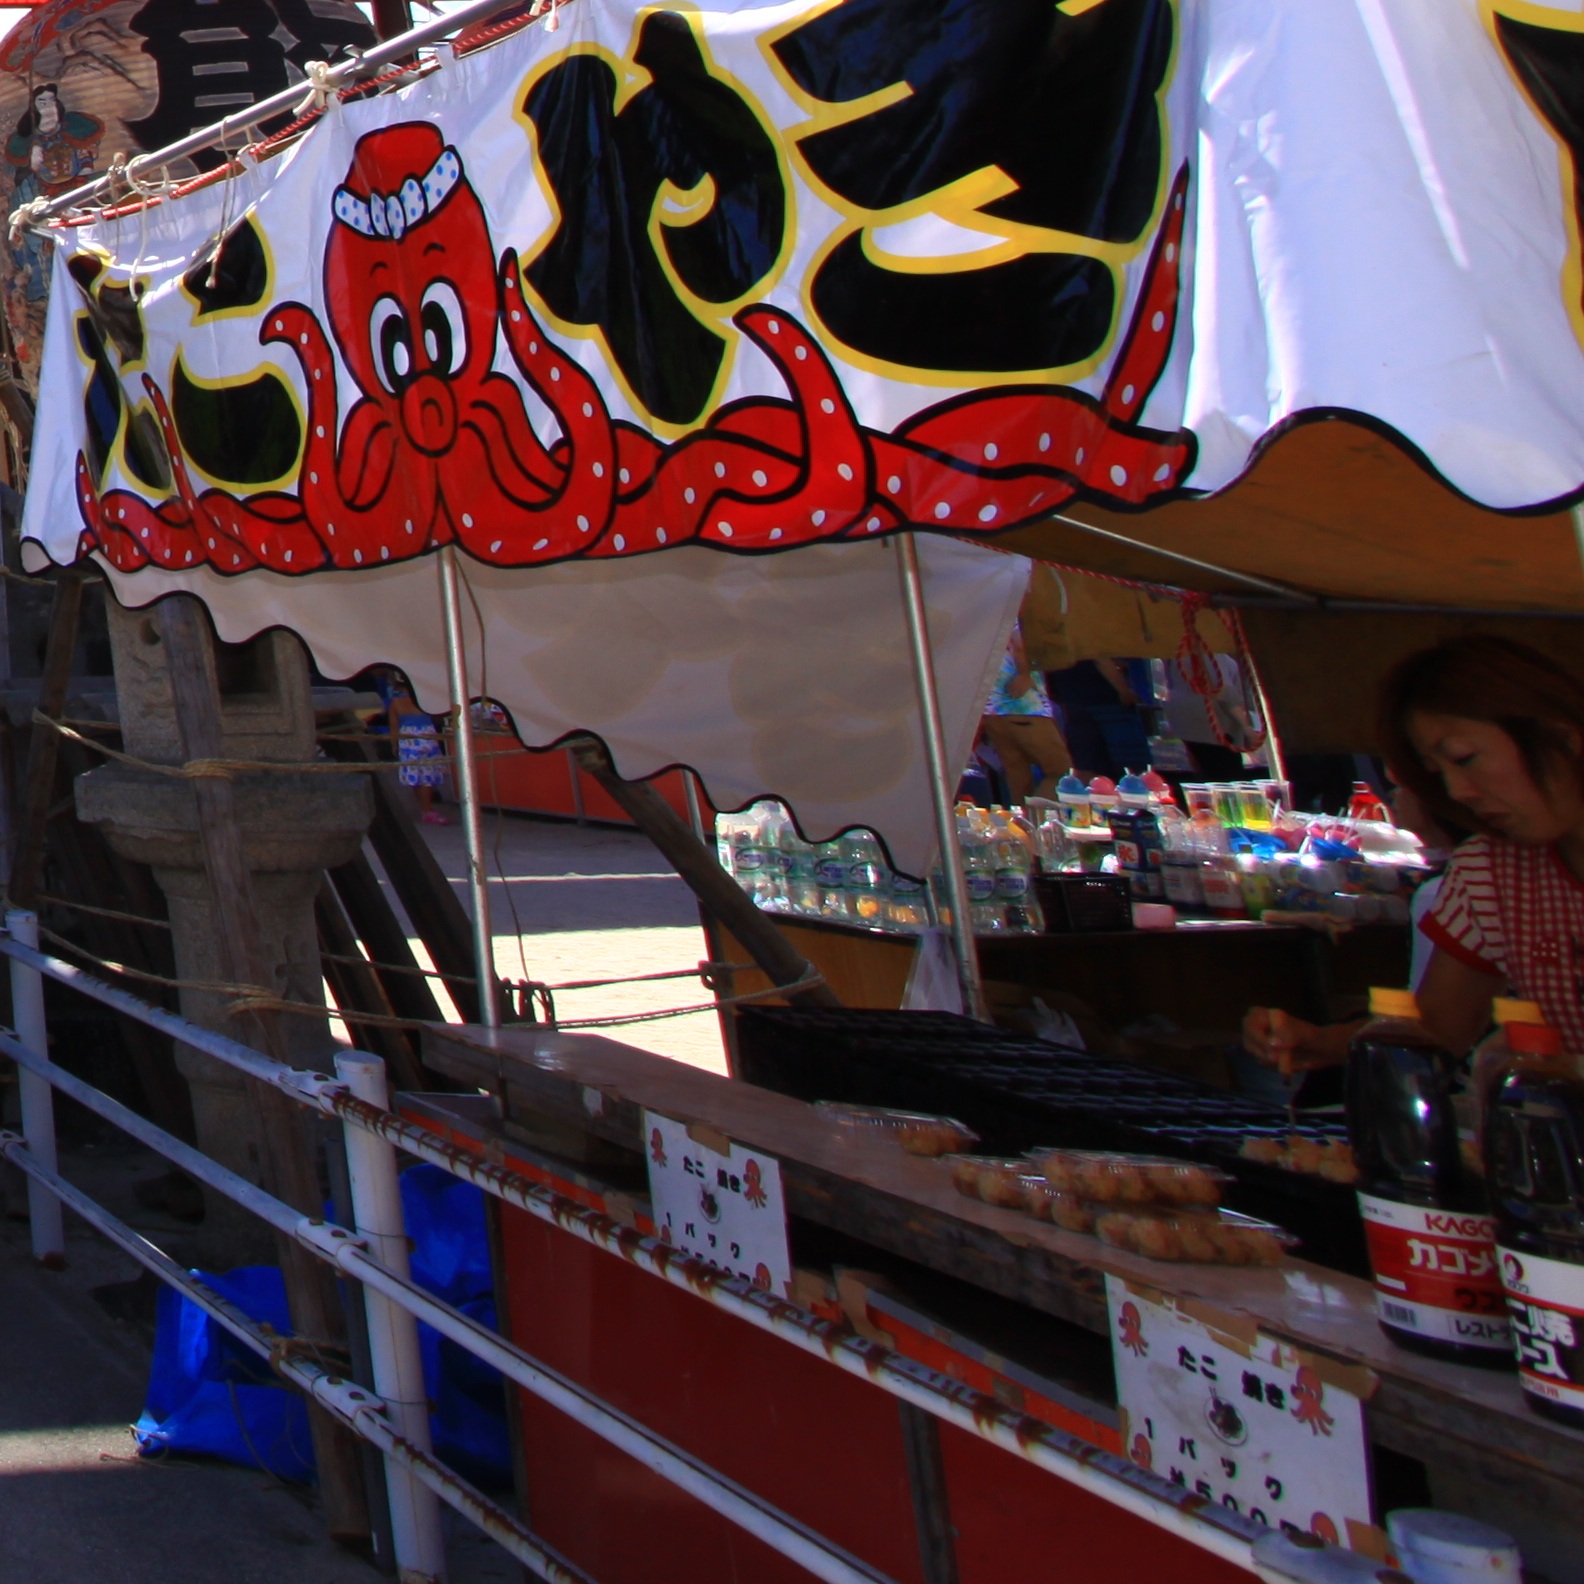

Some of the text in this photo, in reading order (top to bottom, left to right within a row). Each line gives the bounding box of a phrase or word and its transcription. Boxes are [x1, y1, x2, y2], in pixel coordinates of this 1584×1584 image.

[683, 1155, 705, 1179] たこ
[1178, 1345, 1286, 1411] たこ 焼き
